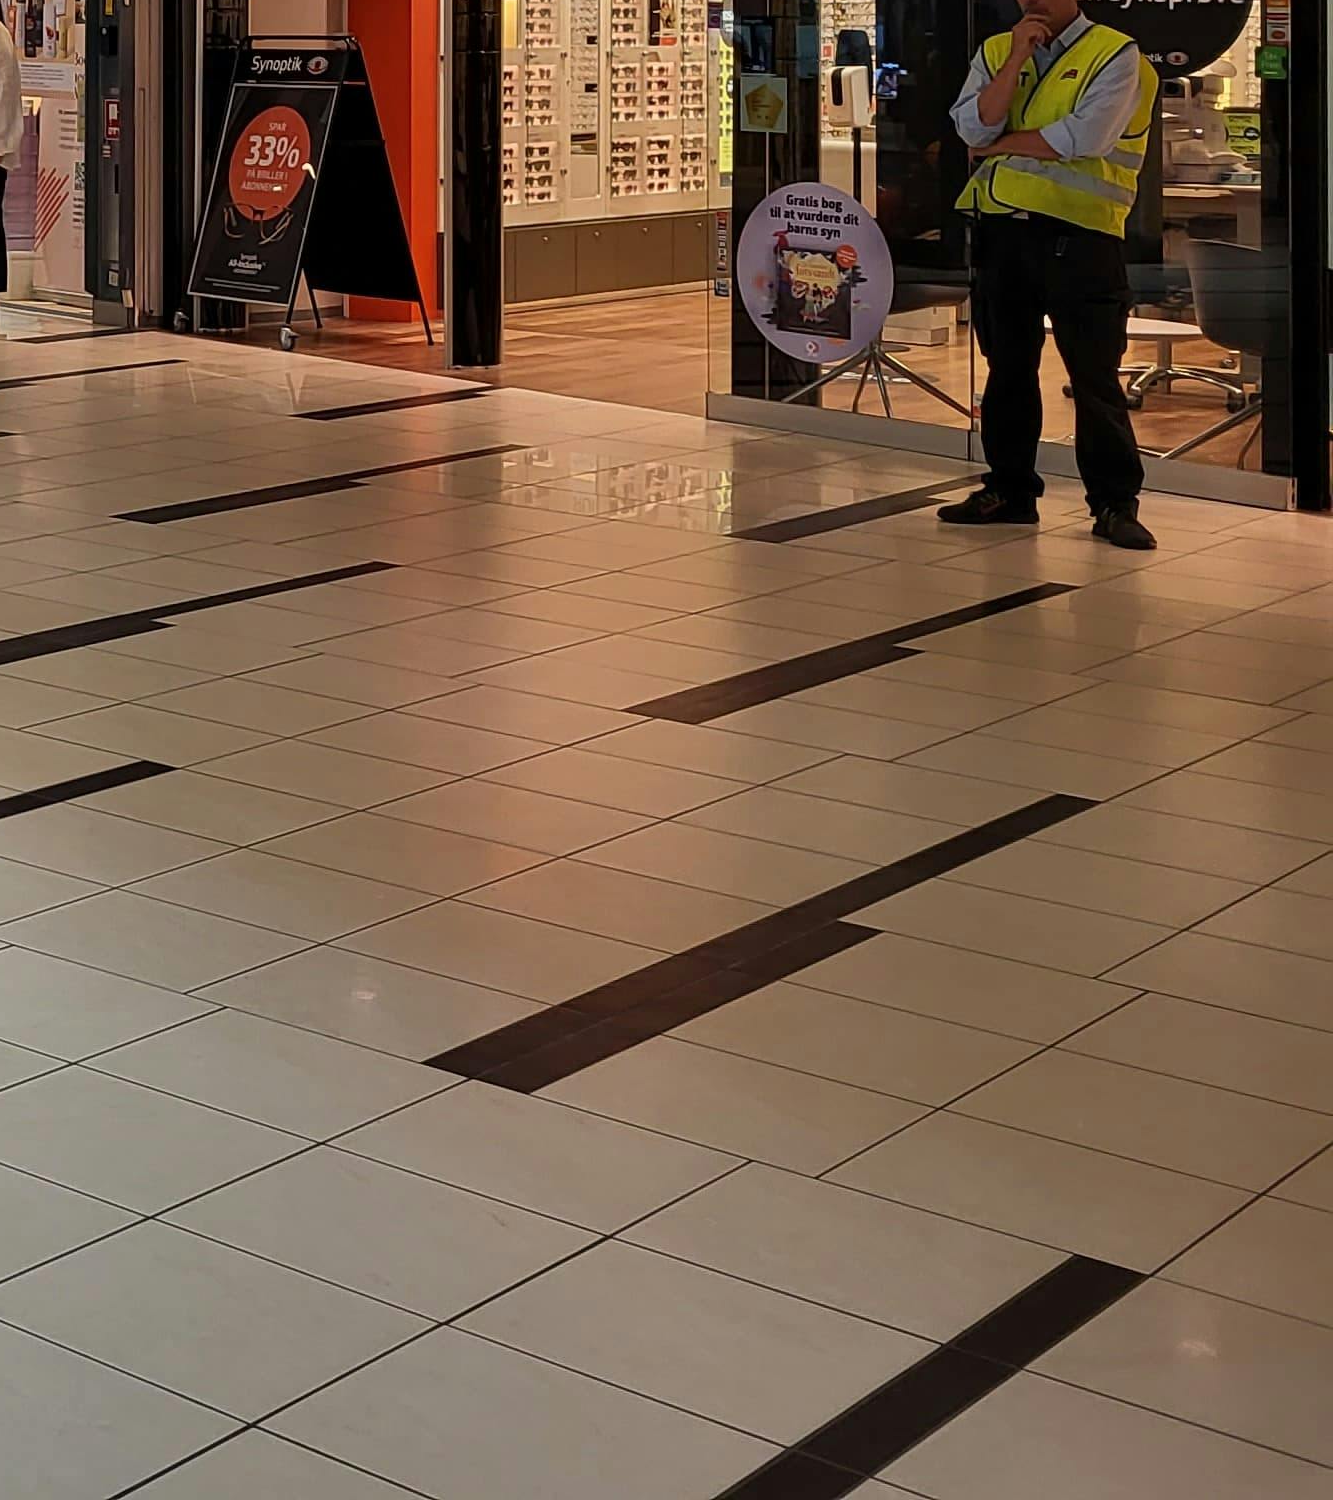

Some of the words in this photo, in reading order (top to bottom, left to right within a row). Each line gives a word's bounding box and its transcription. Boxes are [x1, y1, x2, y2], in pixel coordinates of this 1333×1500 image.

[251, 55, 302, 74] Synoptik
[1020, 71, 1030, 87] T
[268, 122, 287, 131] SPAR
[244, 134, 300, 168] 33%
[786, 194, 818, 208] Gratis
[821, 197, 843, 212] bog
[770, 206, 781, 218] til
[783, 210, 795, 219] at
[797, 211, 841, 224] vurdere
[843, 213, 859, 226] dit
[787, 222, 818, 236] barns
[820, 227, 841, 240] syn
